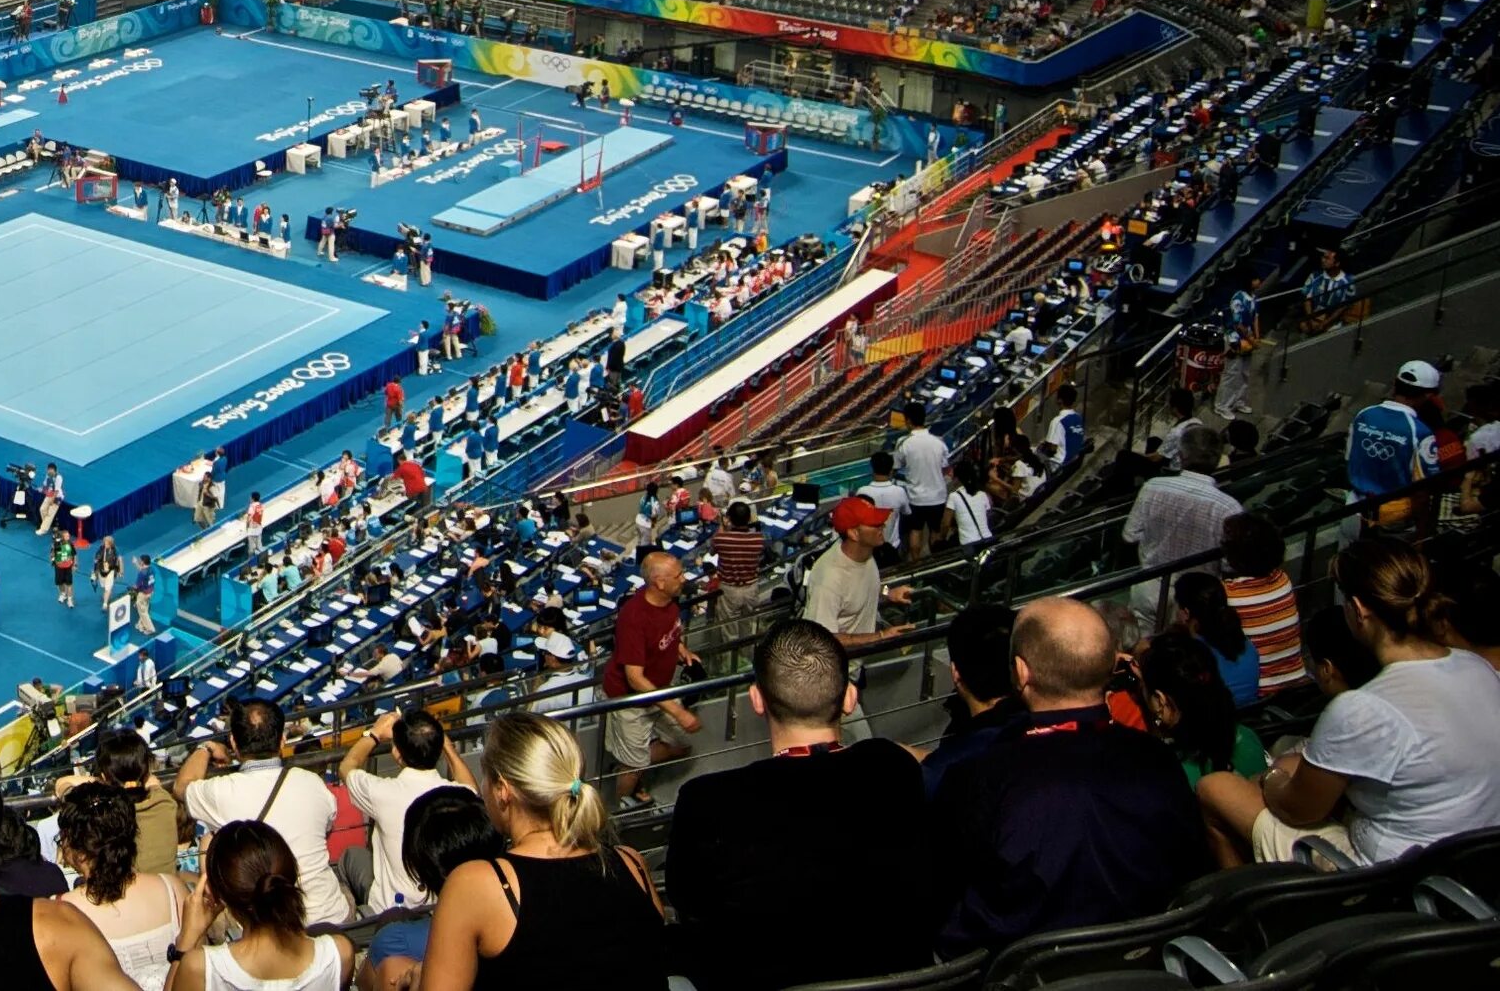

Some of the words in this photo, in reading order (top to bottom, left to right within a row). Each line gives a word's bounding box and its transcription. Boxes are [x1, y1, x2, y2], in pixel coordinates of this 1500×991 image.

[415, 166, 470, 184] Beijing
[589, 206, 644, 224] Beijing
[191, 399, 267, 429] Beijing
[257, 377, 305, 402] 2008
[1357, 422, 1384, 439] Beijing
